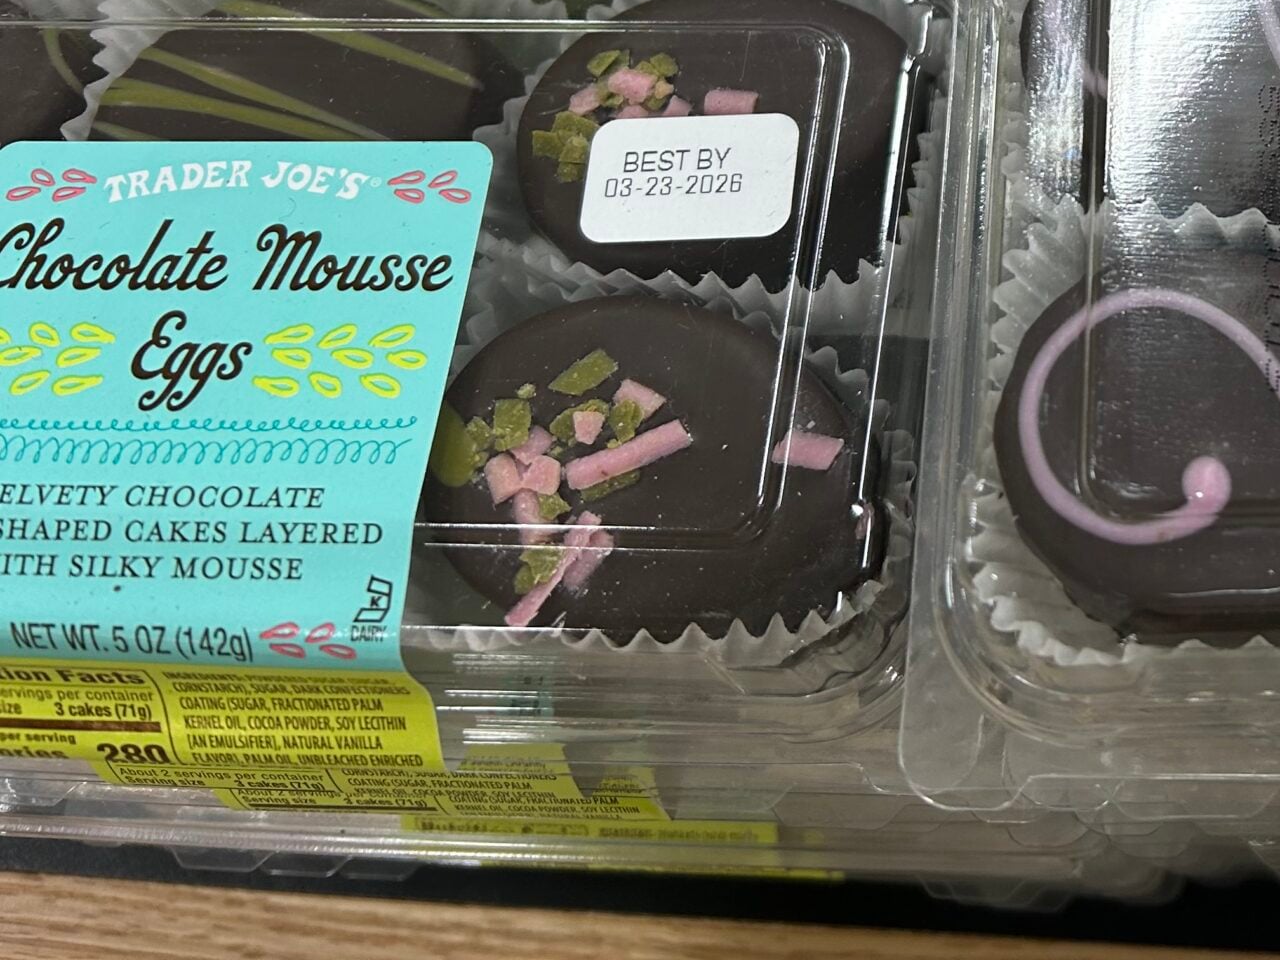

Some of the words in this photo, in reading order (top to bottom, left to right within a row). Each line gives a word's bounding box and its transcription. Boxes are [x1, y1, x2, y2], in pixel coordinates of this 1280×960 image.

[623, 149, 691, 173] BEST
[697, 147, 732, 170] BY
[103, 160, 252, 203] TRADER
[604, 173, 743, 198] 03-23-2026
[252, 223, 454, 291] Mousse
[130, 309, 254, 413] Eggs
[124, 485, 325, 508] CHOCOLATE
[124, 520, 227, 544] CAKES
[238, 522, 383, 545] LAYERED
[0, 554, 57, 576] ITH
[69, 555, 164, 579] SILKY
[171, 556, 304, 580] MOUSSE
[10, 622, 55, 649] NET
[61, 623, 108, 652] WT.
[113, 625, 128, 652] 5
[136, 625, 170, 654] OZ
[176, 627, 253, 662] (142g)
[350, 625, 387, 643] DAIRY
[96, 743, 171, 764] 280
